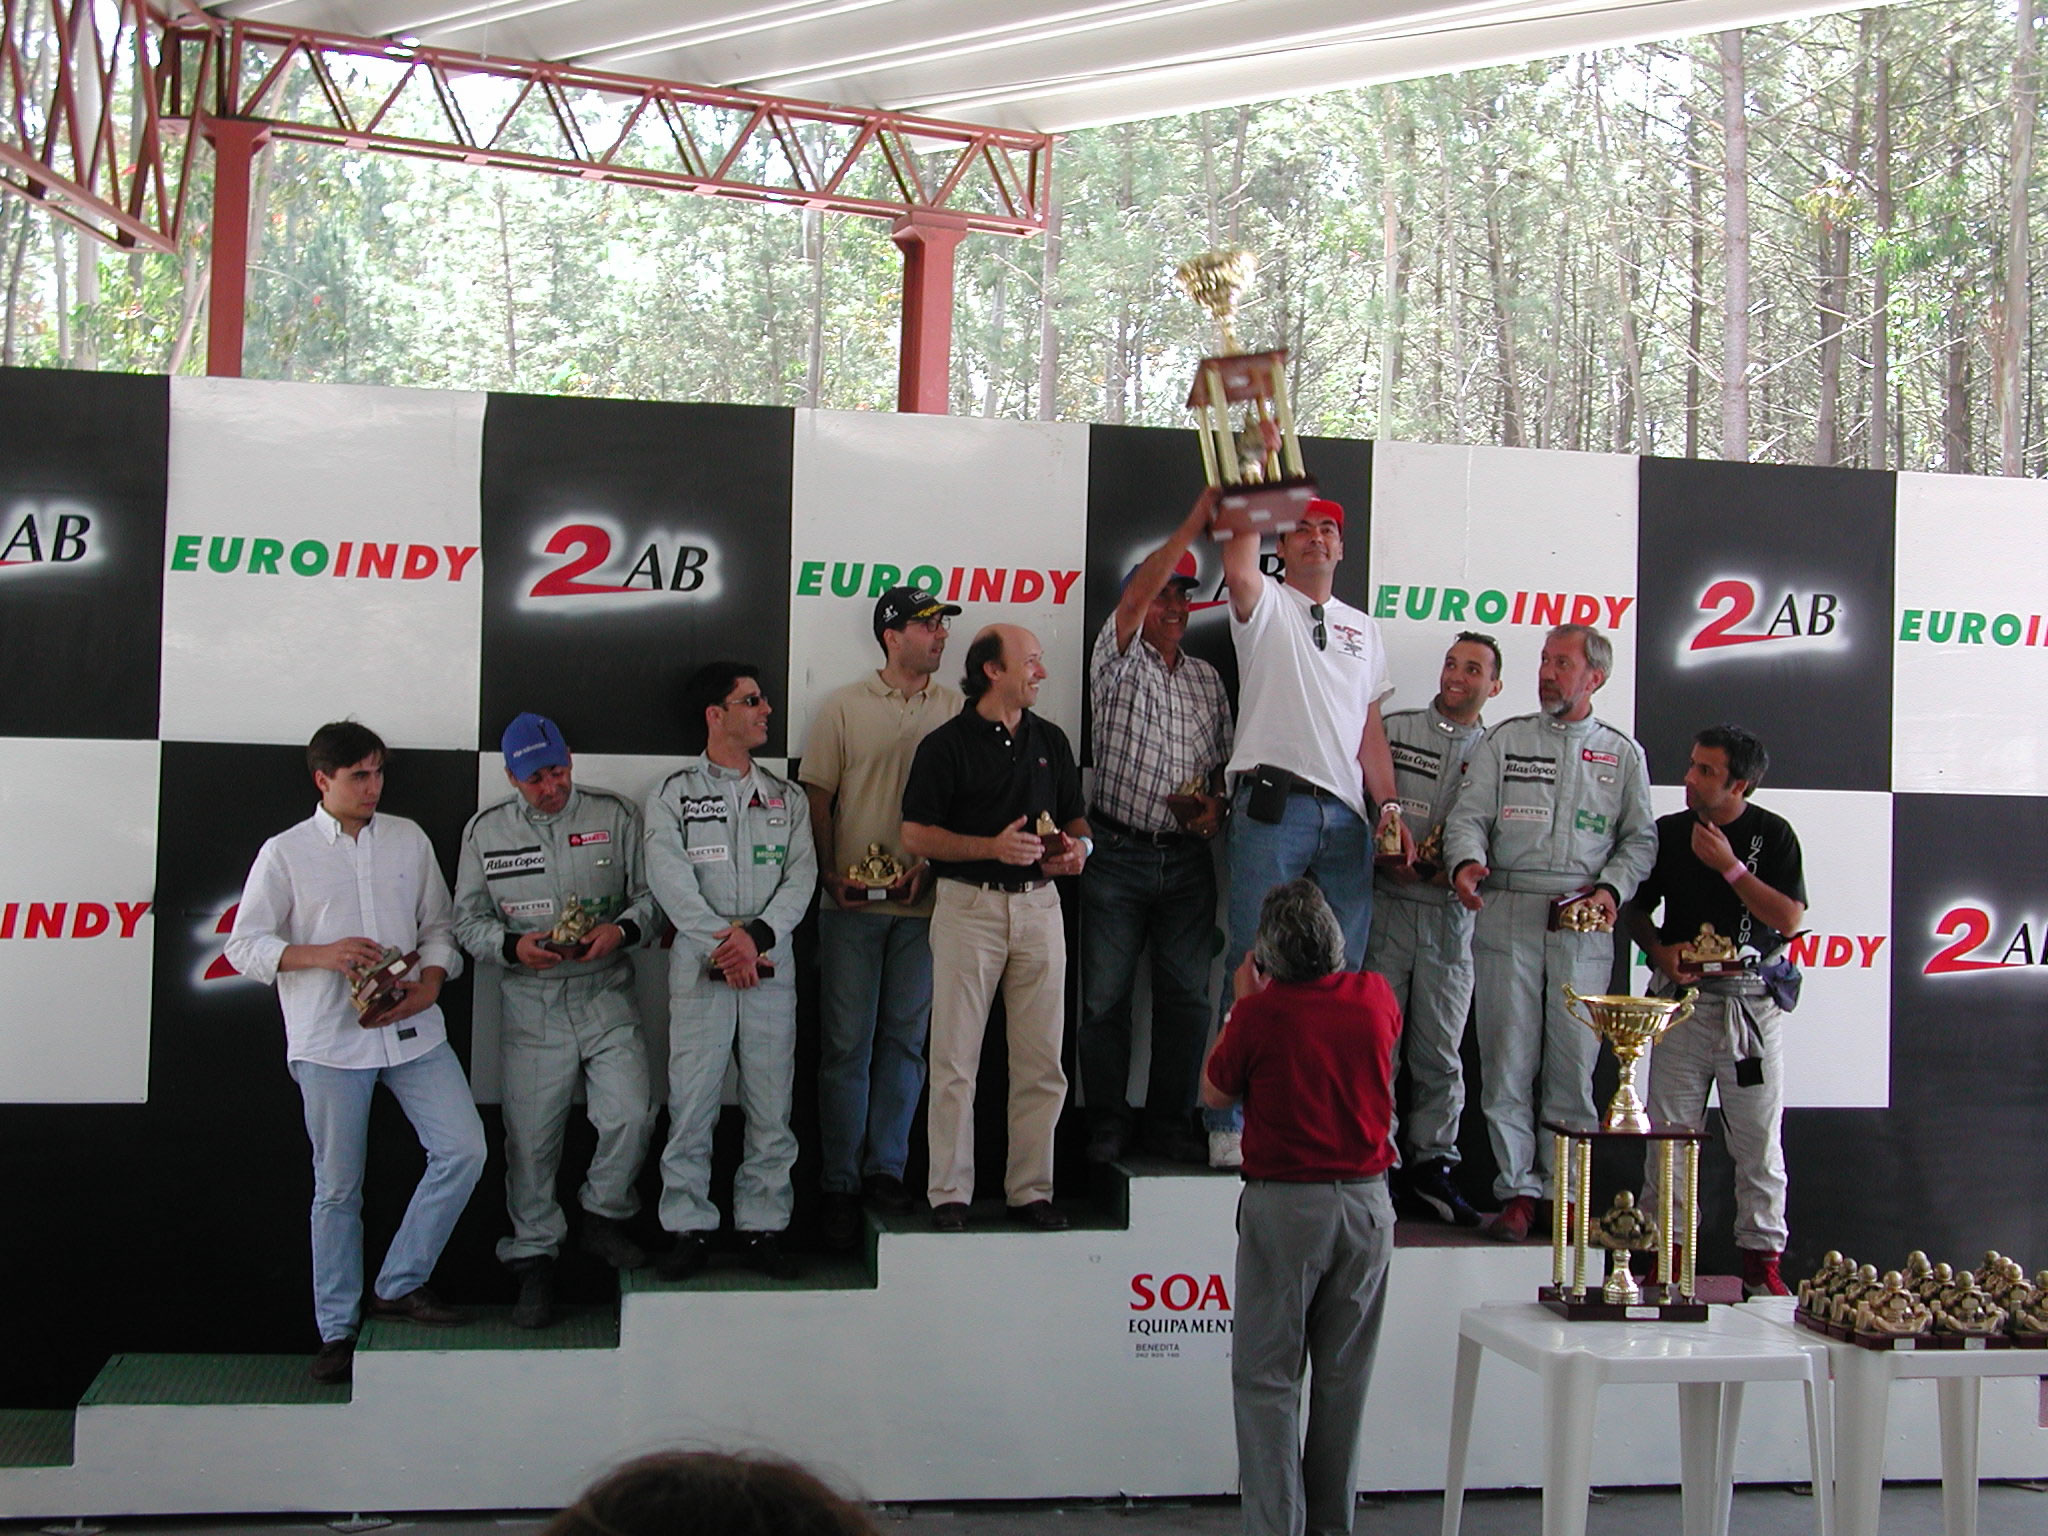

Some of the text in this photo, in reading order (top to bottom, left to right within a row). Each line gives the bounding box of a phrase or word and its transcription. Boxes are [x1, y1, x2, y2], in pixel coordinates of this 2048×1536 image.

[170, 535, 480, 581] EUROINDY
[796, 561, 1082, 604] EUROINDY
[1373, 585, 1635, 629] EUROINDY
[1899, 609, 2048, 647] EUROI
[1504, 763, 1557, 775] Atlas Copco
[485, 856, 545, 872] Atlas Copco
[1924, 908, 2048, 974] 2A
[1129, 1273, 1232, 1311] SOA
[1135, 1343, 1180, 1352] BENEDITA
